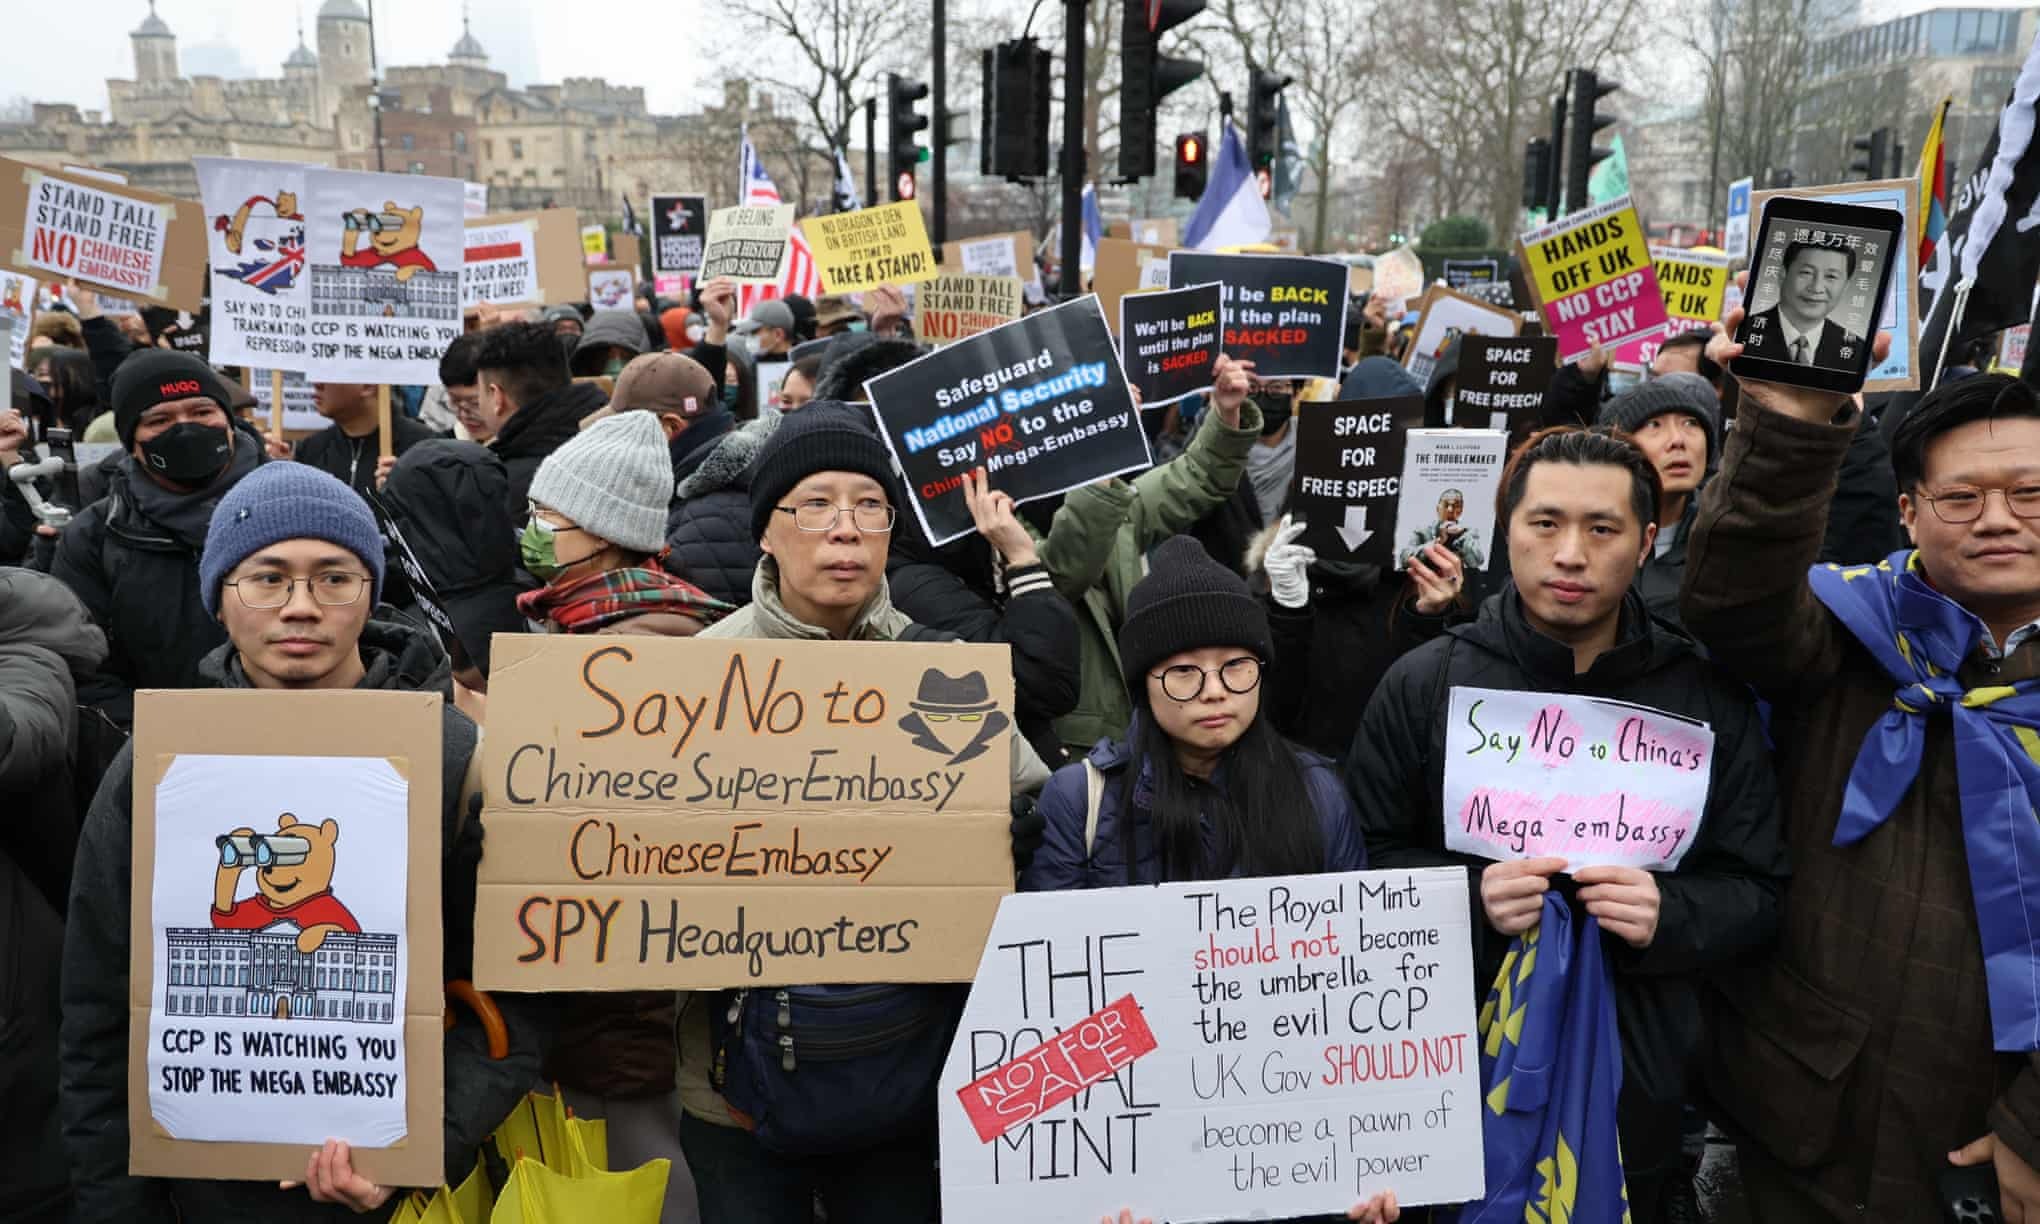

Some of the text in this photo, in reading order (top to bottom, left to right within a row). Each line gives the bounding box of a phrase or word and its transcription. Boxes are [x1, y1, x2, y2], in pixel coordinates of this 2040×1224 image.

[40, 183, 157, 230] STAND TALL
[37, 204, 157, 252] STAND FREE
[821, 219, 835, 234] NO
[836, 212, 881, 232] DRAGON'S
[825, 223, 907, 250] ON BRITISH LAND
[32, 227, 77, 268] NO
[80, 239, 153, 272] CHINESE
[863, 246, 881, 259] TIME
[883, 244, 891, 255] TO
[1541, 215, 1624, 264] HANDS
[78, 259, 151, 289] EMBASSY!
[498, 260, 528, 279] ROOTS
[827, 251, 927, 286] TAKE A STAND!
[1551, 260, 1592, 293] OFF
[1598, 245, 1635, 276] UK
[472, 283, 491, 300] THE
[922, 276, 1014, 298] STAND TALL
[1240, 285, 1264, 302] be
[1270, 286, 1329, 305] BACK
[1556, 292, 1591, 323] NO
[1595, 271, 1644, 308] CCP
[224, 300, 245, 314] SAY
[250, 303, 265, 316] NO
[269, 303, 281, 318] TO
[286, 305, 306, 319] CHI
[922, 294, 1014, 316] STAND FREE
[1240, 308, 1273, 324] the
[1278, 308, 1322, 327] plan
[1680, 292, 1708, 316] UK
[233, 317, 306, 336] TRANSNATION
[311, 321, 460, 340] CCP IS WATCHING YOU
[923, 310, 958, 339] NO
[1135, 319, 1168, 337] We'll
[1171, 318, 1185, 331] be
[1187, 309, 1215, 329] BACK
[1223, 328, 1308, 345] SACKED
[1581, 305, 1637, 344] STAY
[311, 343, 340, 359] STOP
[344, 344, 364, 359] THE
[369, 345, 403, 360] MEGA
[1139, 331, 1214, 356] until the plan
[1484, 347, 1532, 363] SPACE
[935, 347, 1053, 407] Safeguard
[1147, 350, 1209, 374] is SACKED
[1489, 370, 1518, 386] FOR
[160, 380, 201, 395] HUGO
[1458, 390, 1543, 409] FREE SPEECH
[903, 360, 1107, 453] National Security
[937, 399, 1094, 467] Say NO to the
[1334, 412, 1393, 436] SPACE
[986, 411, 1130, 473] Mega-Embassy
[1340, 447, 1376, 468] FOR
[1415, 453, 1497, 465] THE TROUBLEMAKER
[1301, 476, 1400, 499] FREE SPEEC
[823, 680, 885, 723] to
[1466, 699, 1701, 771] Say No to China's
[1184, 876, 1420, 932] The Royal Mint
[517, 896, 919, 978] SPY Headquarters
[1194, 917, 1440, 970] should not become
[998, 933, 1145, 1020] THE
[1192, 952, 1440, 1005] the umbrella for
[1193, 986, 1429, 1044] the evil CCP
[162, 1028, 397, 1061] CCP IS WATCHING YOU
[978, 1010, 1128, 1107] NOT FOR
[162, 1066, 398, 1098] STOP THE MEGA EMBASSY
[996, 1034, 1136, 1131] SALE
[1191, 1034, 1467, 1100] UK Gov SHOULD NOT
[1203, 1089, 1453, 1152] become a pawn of
[994, 1112, 1153, 1184] MINT
[1228, 1142, 1430, 1195] the evil power
